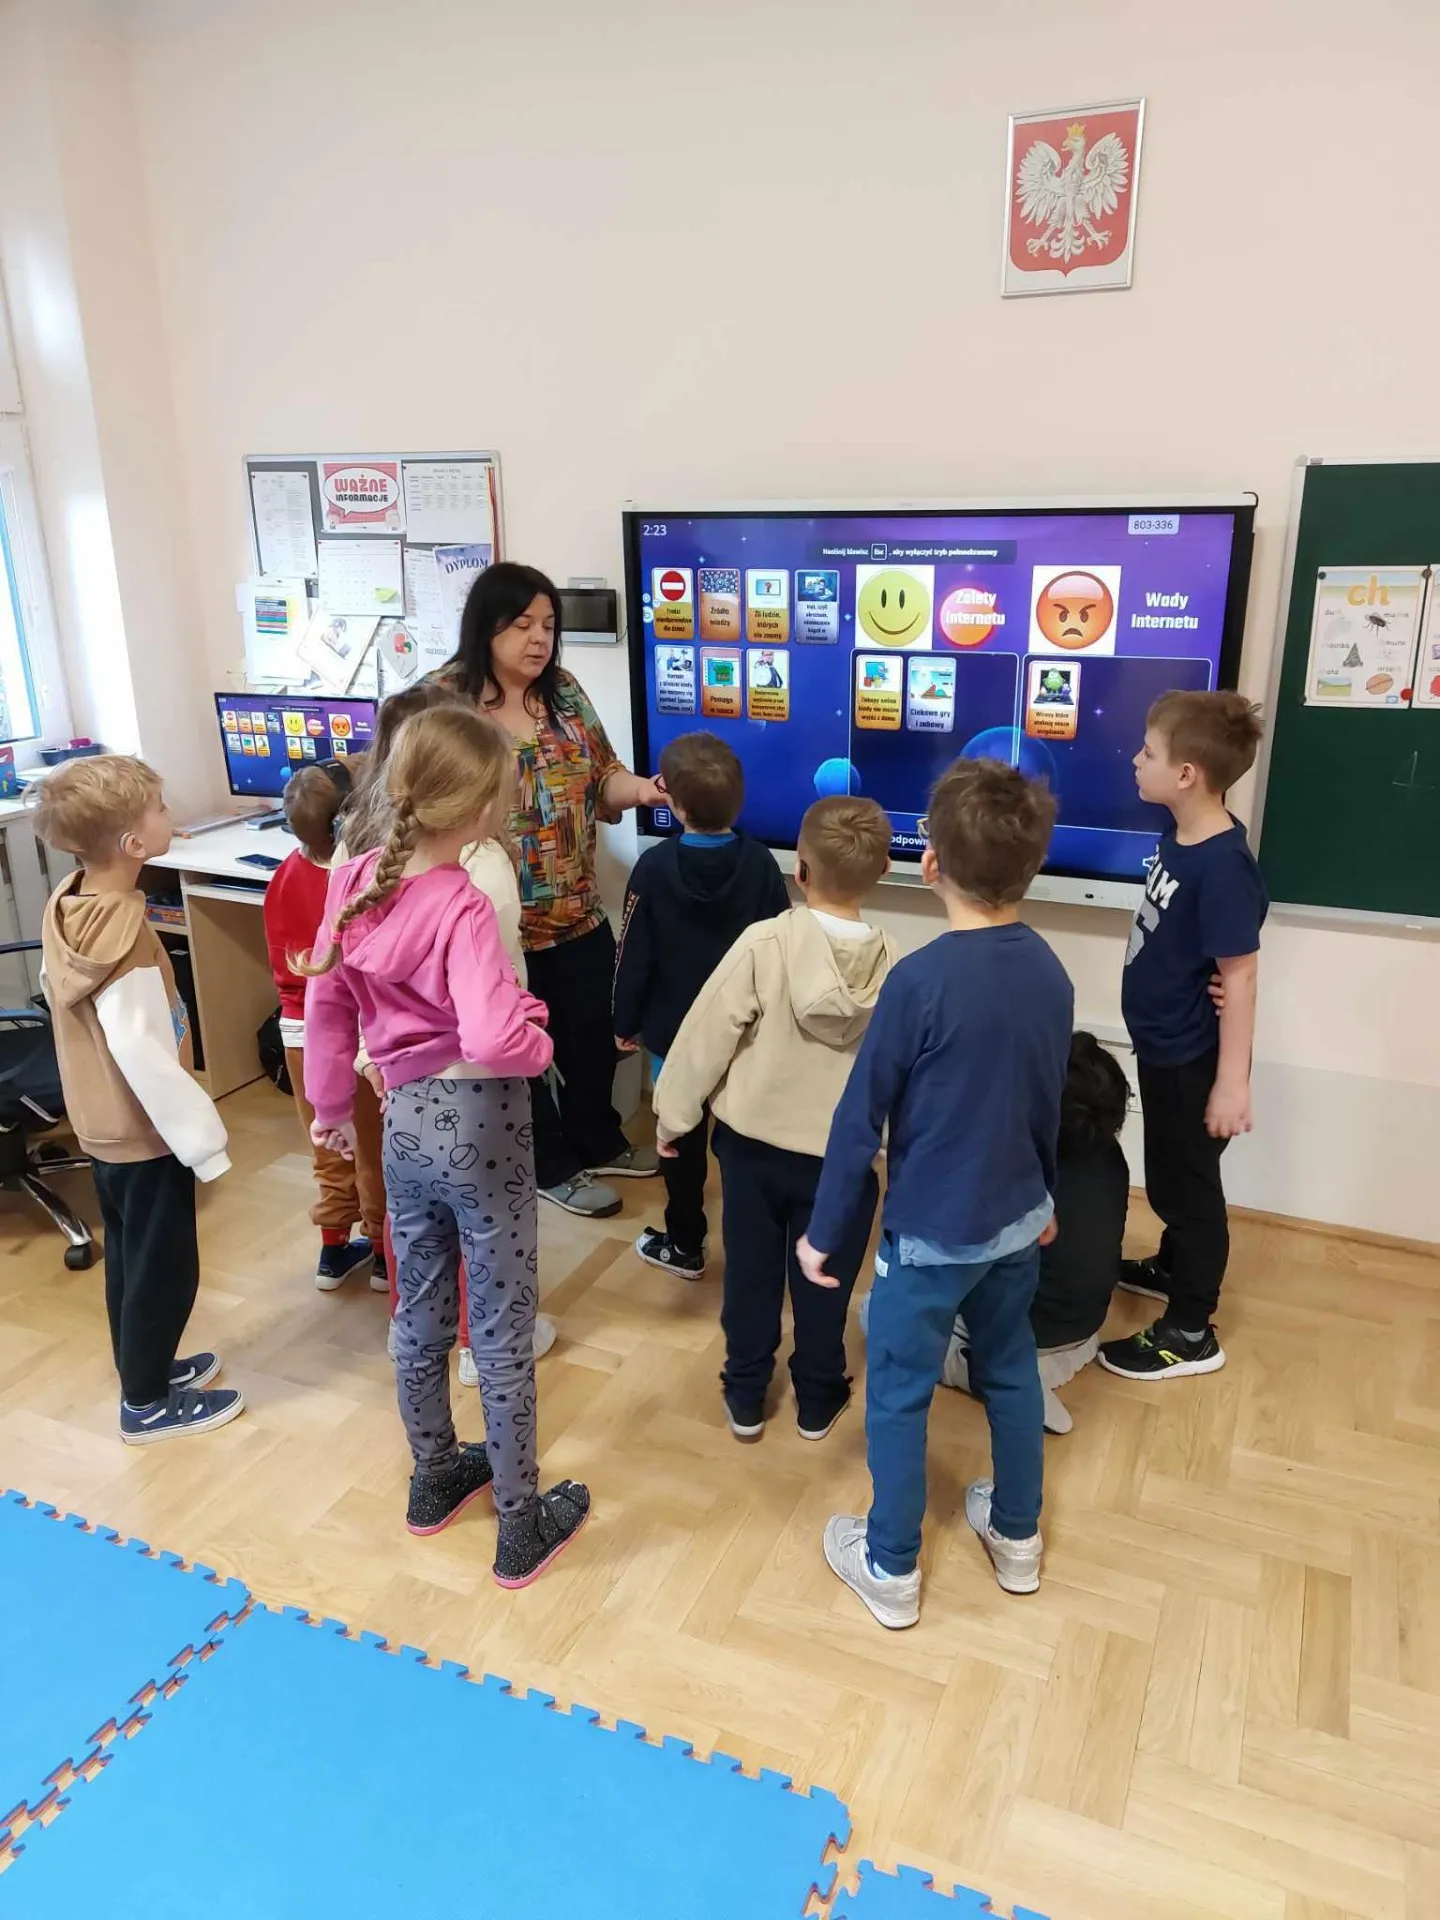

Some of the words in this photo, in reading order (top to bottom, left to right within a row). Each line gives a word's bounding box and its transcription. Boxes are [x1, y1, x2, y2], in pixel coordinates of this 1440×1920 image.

[335, 474, 387, 492] WAŻNE
[336, 494, 388, 502] INFORMACJE
[643, 524, 667, 536] 2:23
[1133, 519, 1174, 530] 803-336
[445, 556, 488, 574] DYPLOM
[1347, 574, 1390, 606] ch
[956, 591, 997, 607] Zalety
[1146, 592, 1189, 610] Wady
[710, 606, 730, 614] Źródło
[945, 611, 1005, 625] Internetu
[1131, 614, 1198, 629] Internetu
[757, 621, 778, 629] których
[710, 696, 733, 704] Pomaga
[910, 708, 938, 716] Ciekawe
[919, 721, 944, 729] zabawy
